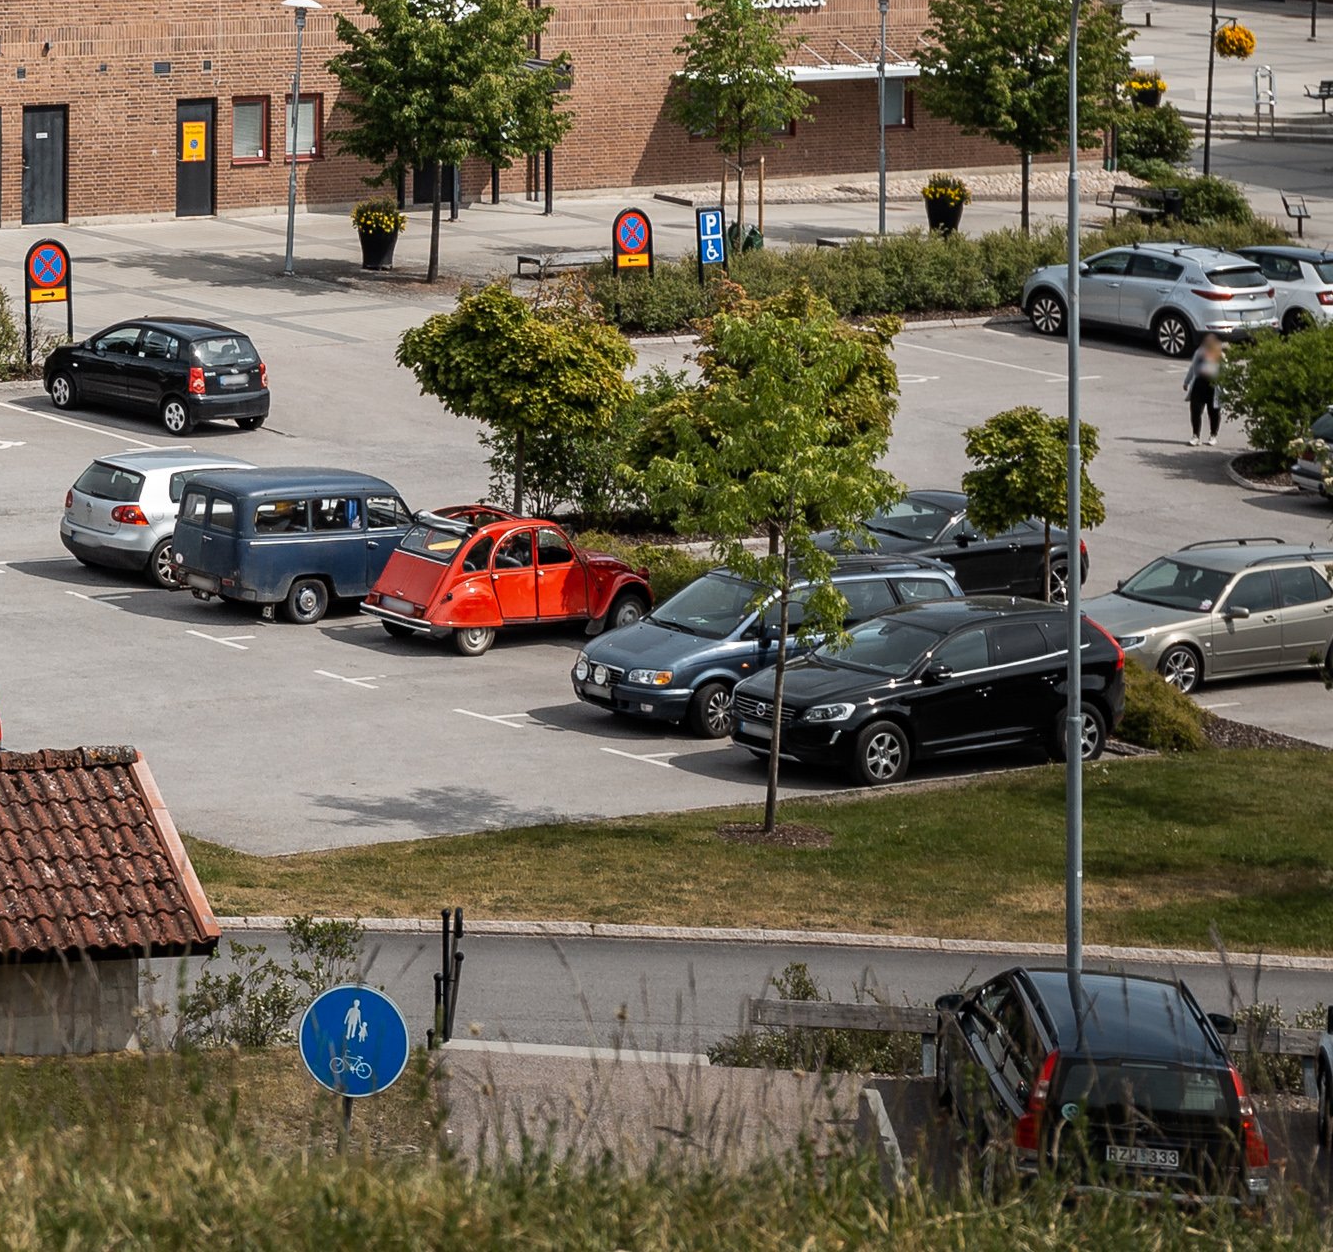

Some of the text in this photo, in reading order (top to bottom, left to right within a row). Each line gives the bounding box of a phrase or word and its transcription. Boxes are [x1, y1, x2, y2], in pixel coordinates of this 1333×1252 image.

[706, 214, 717, 235] P
[1109, 1147, 1177, 1165] RZW 333
